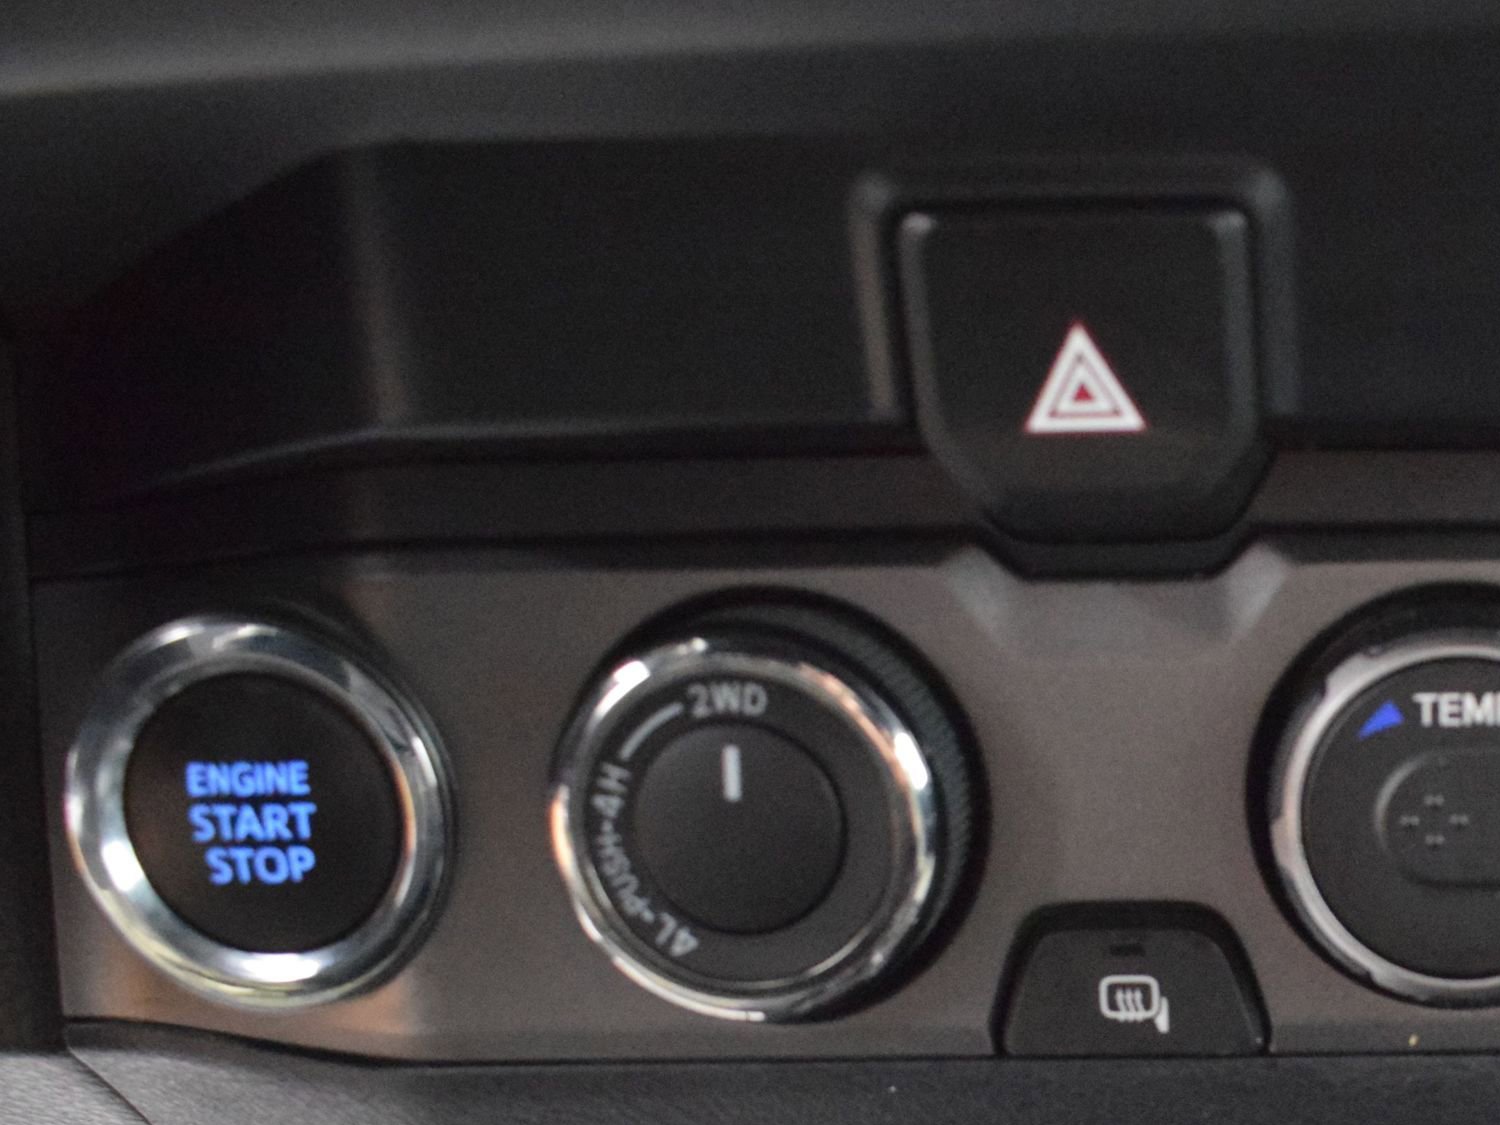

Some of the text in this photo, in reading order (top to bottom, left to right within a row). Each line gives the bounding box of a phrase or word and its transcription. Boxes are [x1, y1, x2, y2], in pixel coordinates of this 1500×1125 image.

[686, 683, 770, 720] 2WD
[186, 760, 310, 797] ENGINE
[189, 802, 316, 843] START
[205, 846, 317, 884] STOP
